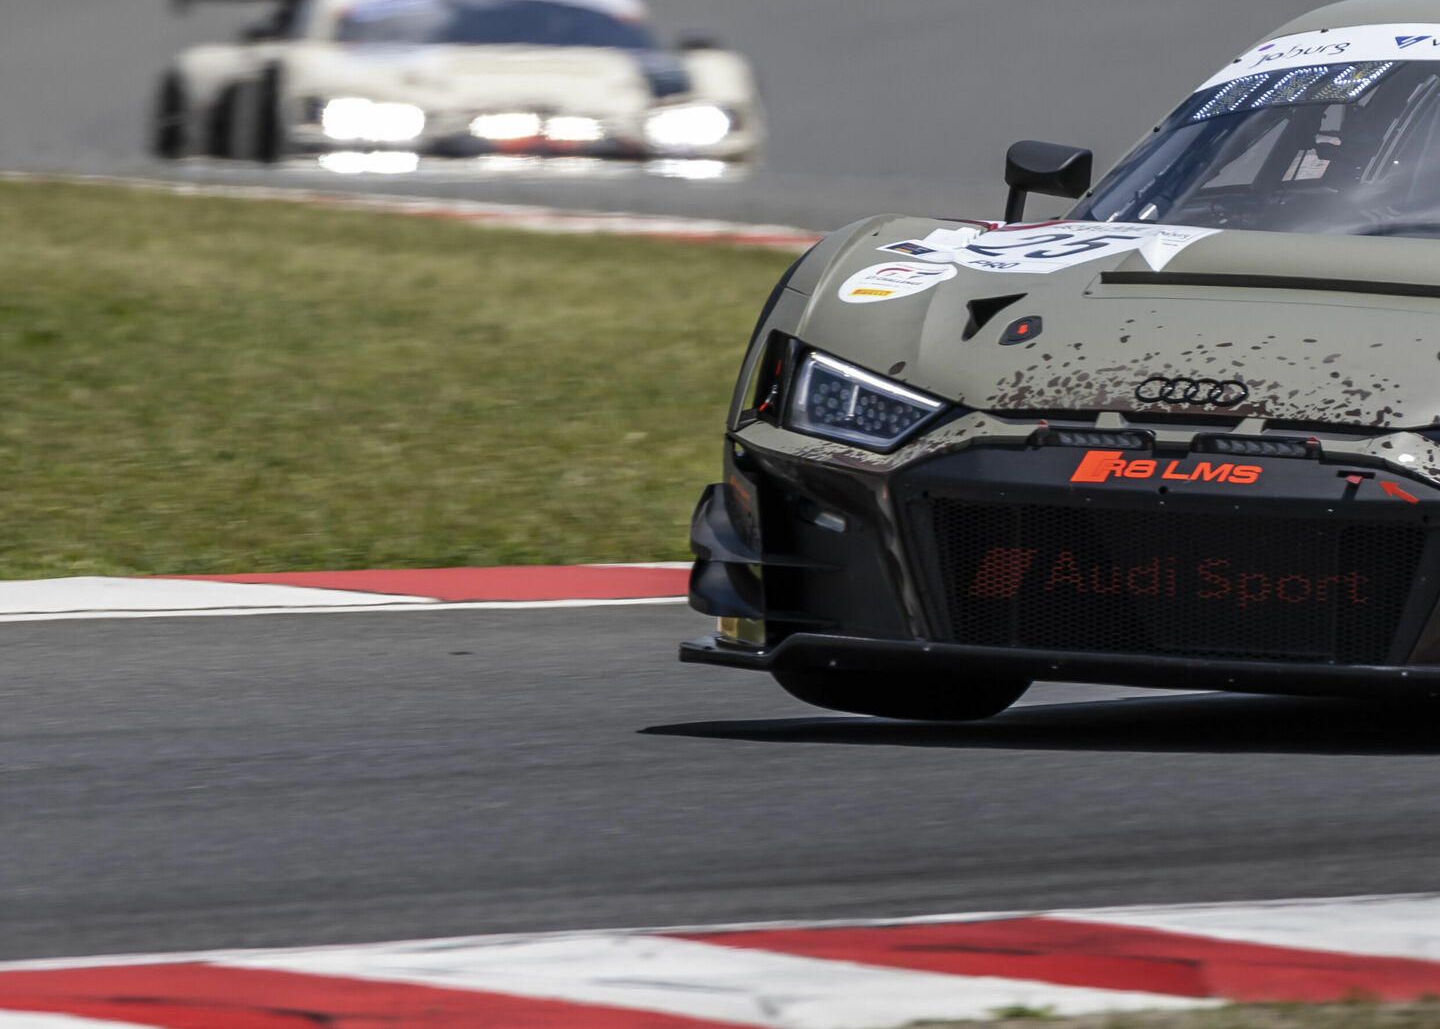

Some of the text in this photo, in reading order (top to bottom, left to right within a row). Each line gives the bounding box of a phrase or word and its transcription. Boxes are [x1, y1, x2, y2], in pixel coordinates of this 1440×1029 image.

[966, 233, 1140, 258] 25
[1096, 459, 1263, 484] R8 LMS
[1045, 551, 1369, 608] Audi Sport
